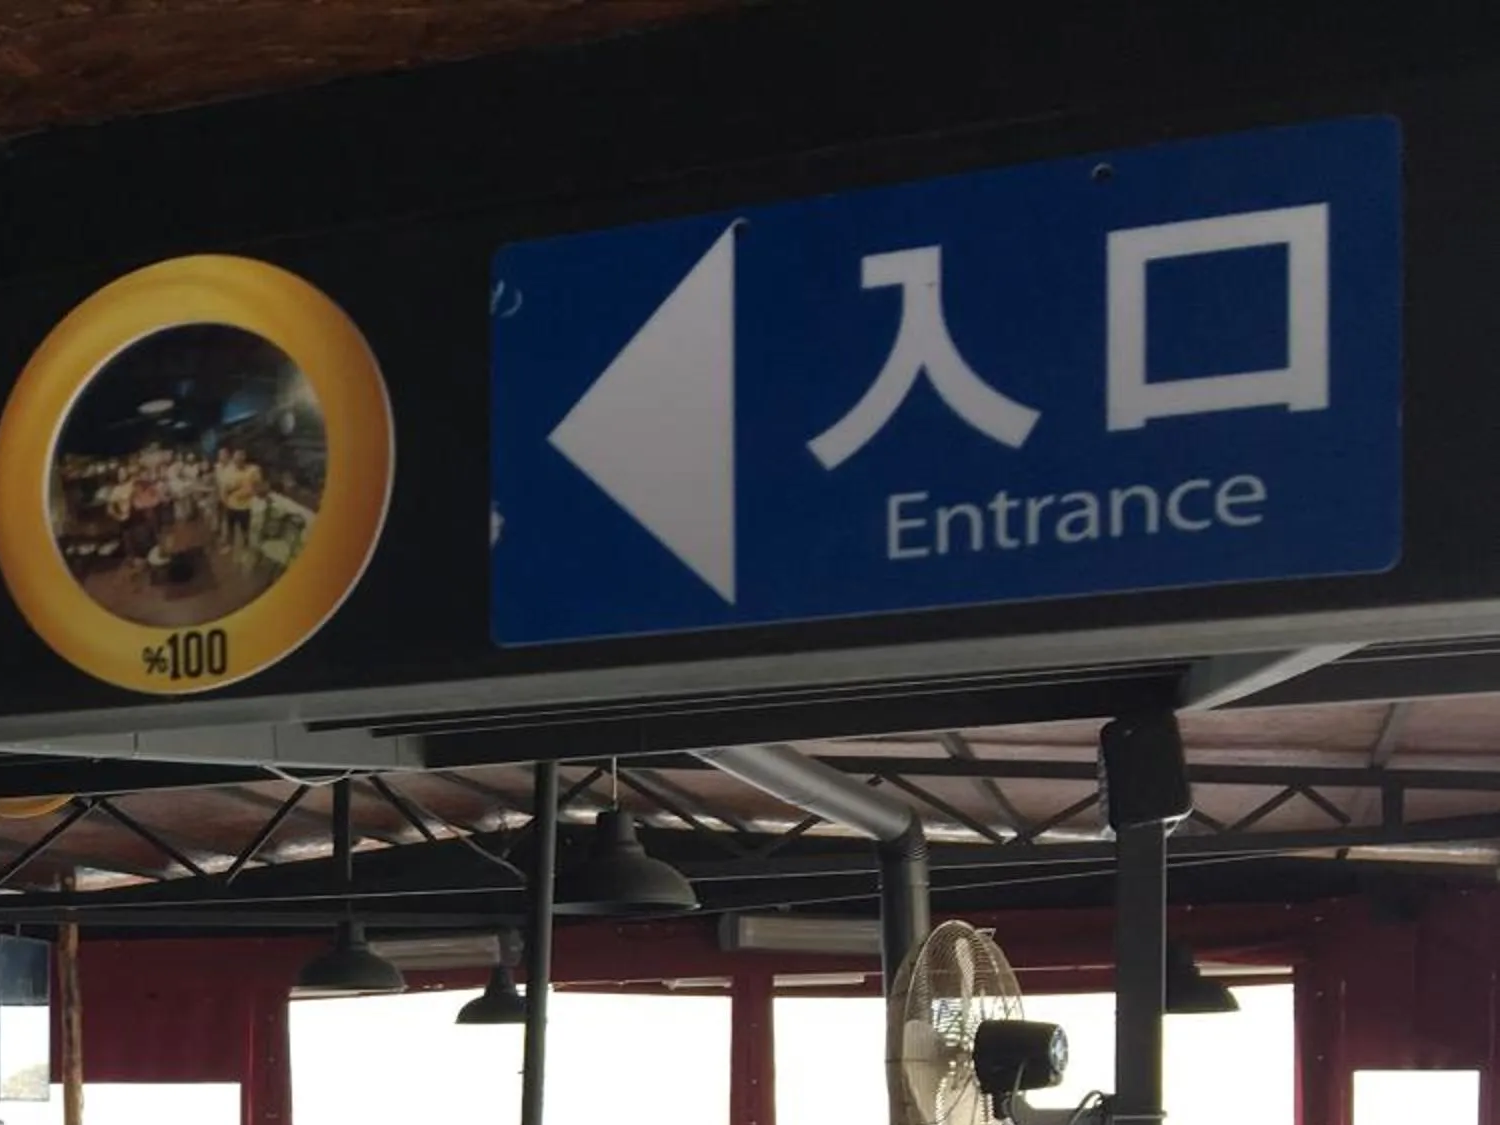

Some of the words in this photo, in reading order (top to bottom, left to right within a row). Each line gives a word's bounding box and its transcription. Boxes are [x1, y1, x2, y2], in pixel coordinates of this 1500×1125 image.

[806, 202, 1330, 471] 入口
[886, 473, 1267, 560] Entrance
[142, 630, 227, 681] %100
